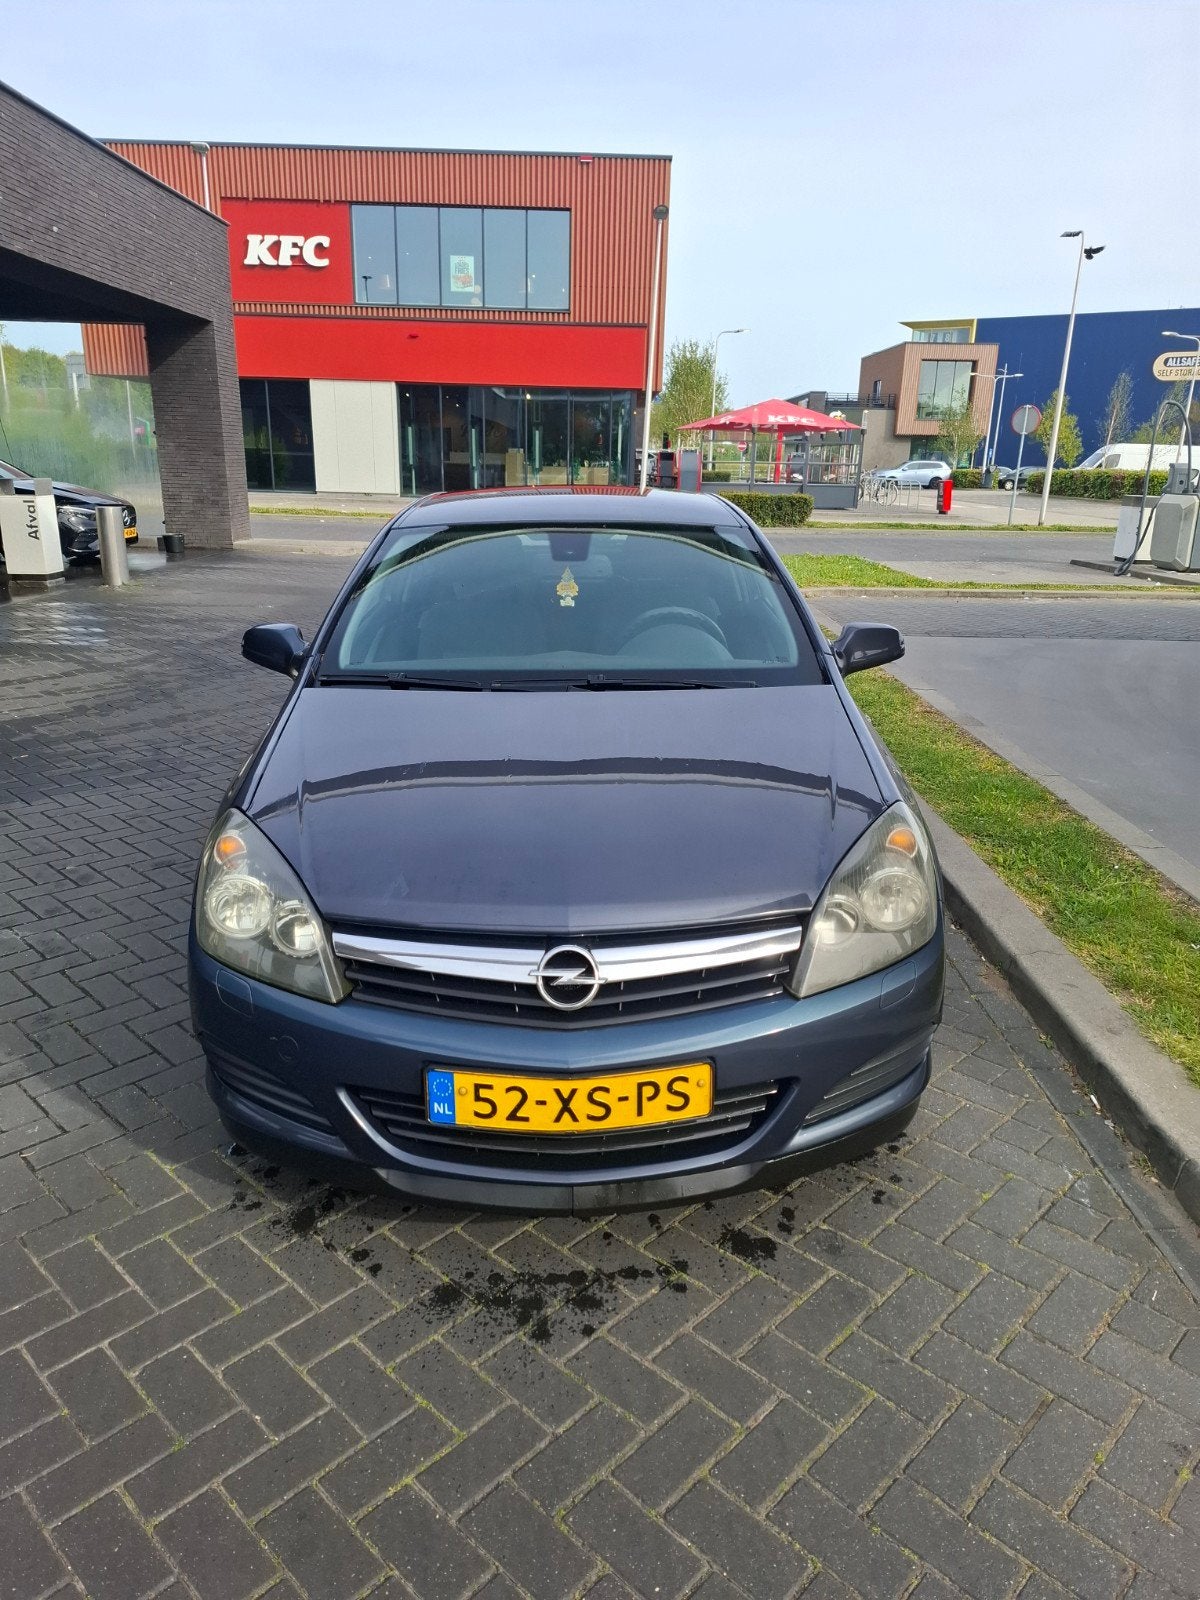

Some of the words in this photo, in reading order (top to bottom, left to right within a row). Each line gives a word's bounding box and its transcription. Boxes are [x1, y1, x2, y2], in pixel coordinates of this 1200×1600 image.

[243, 234, 331, 267] KFC
[1157, 369, 1173, 377] SELF
[767, 414, 817, 425] KFC
[22, 499, 40, 541] Afval
[433, 1103, 453, 1115] NL
[473, 1076, 690, 1124] 52-XS-PS
